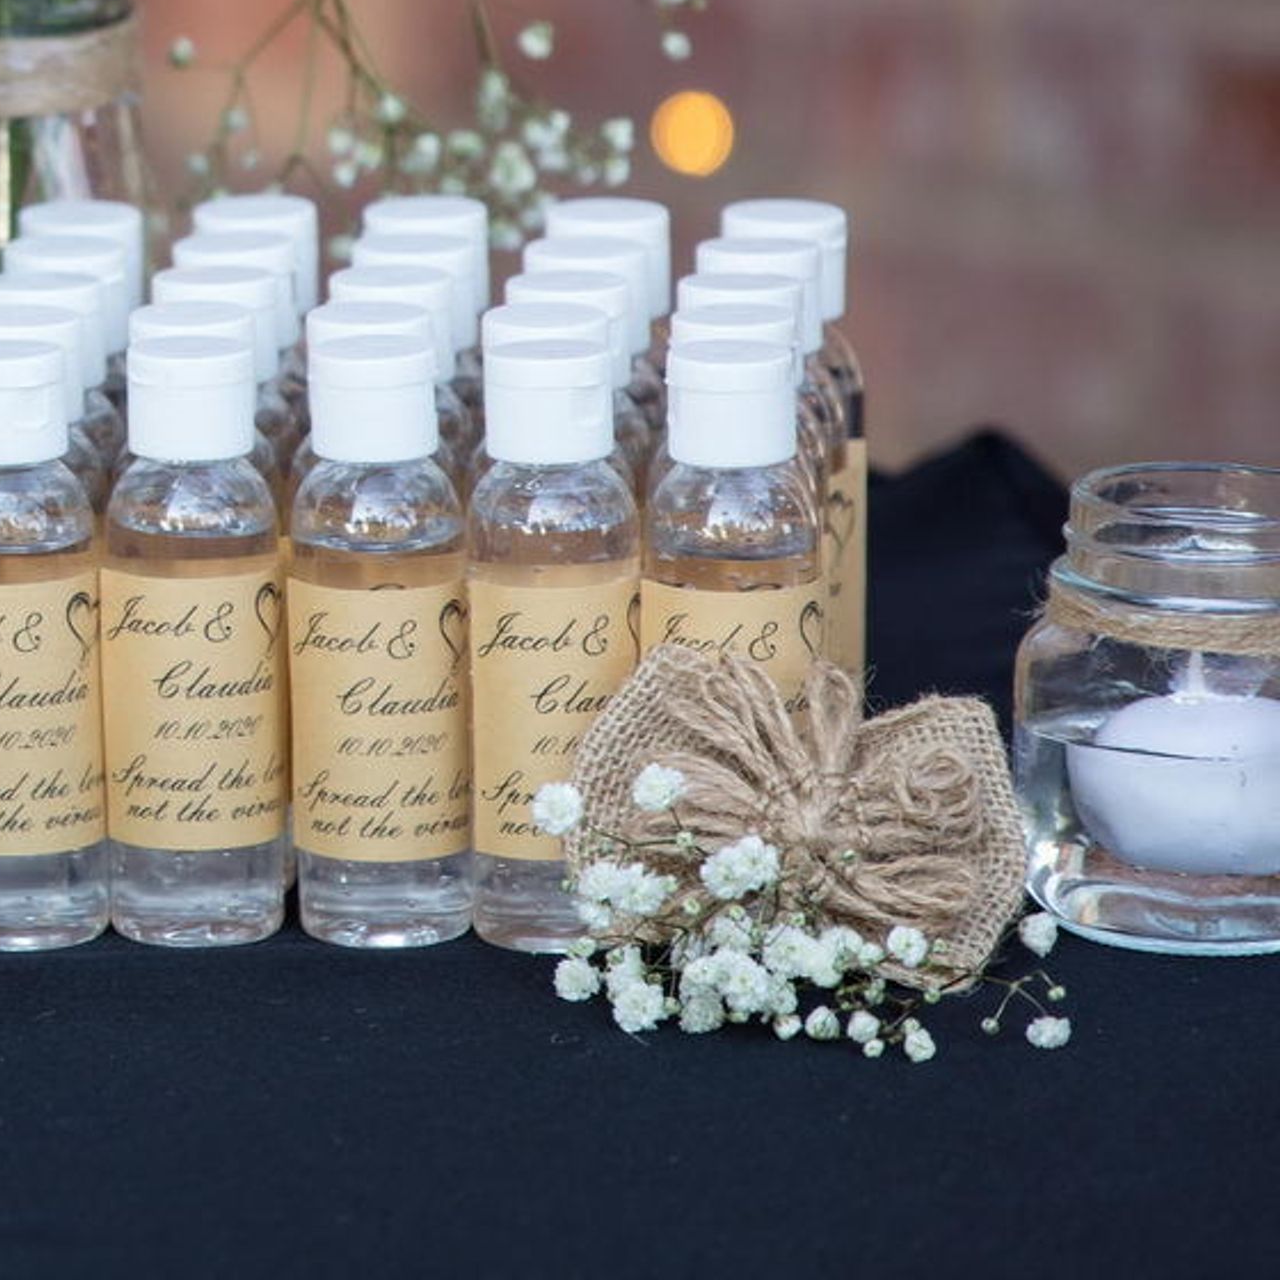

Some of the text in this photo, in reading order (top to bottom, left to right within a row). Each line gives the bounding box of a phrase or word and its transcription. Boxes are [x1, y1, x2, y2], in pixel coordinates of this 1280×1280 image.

[13, 612, 43, 653] &
[107, 595, 234, 643] Jacob &
[293, 612, 417, 660] Jacob &
[478, 611, 610, 658] Jacob &
[748, 621, 778, 662] &
[152, 660, 274, 700] Claudia
[335, 677, 459, 717] Claudia
[530, 674, 612, 716] Clau
[153, 714, 263, 741] 10.10.2020
[336, 733, 448, 757] 10.10.2020
[31, 768, 69, 801] the
[112, 754, 218, 797] Spread
[218, 760, 256, 792] the
[297, 769, 400, 814] Spread
[401, 775, 440, 809] the
[126, 801, 169, 821] not
[176, 794, 220, 823] the
[311, 816, 353, 837] not
[359, 810, 403, 839] the
